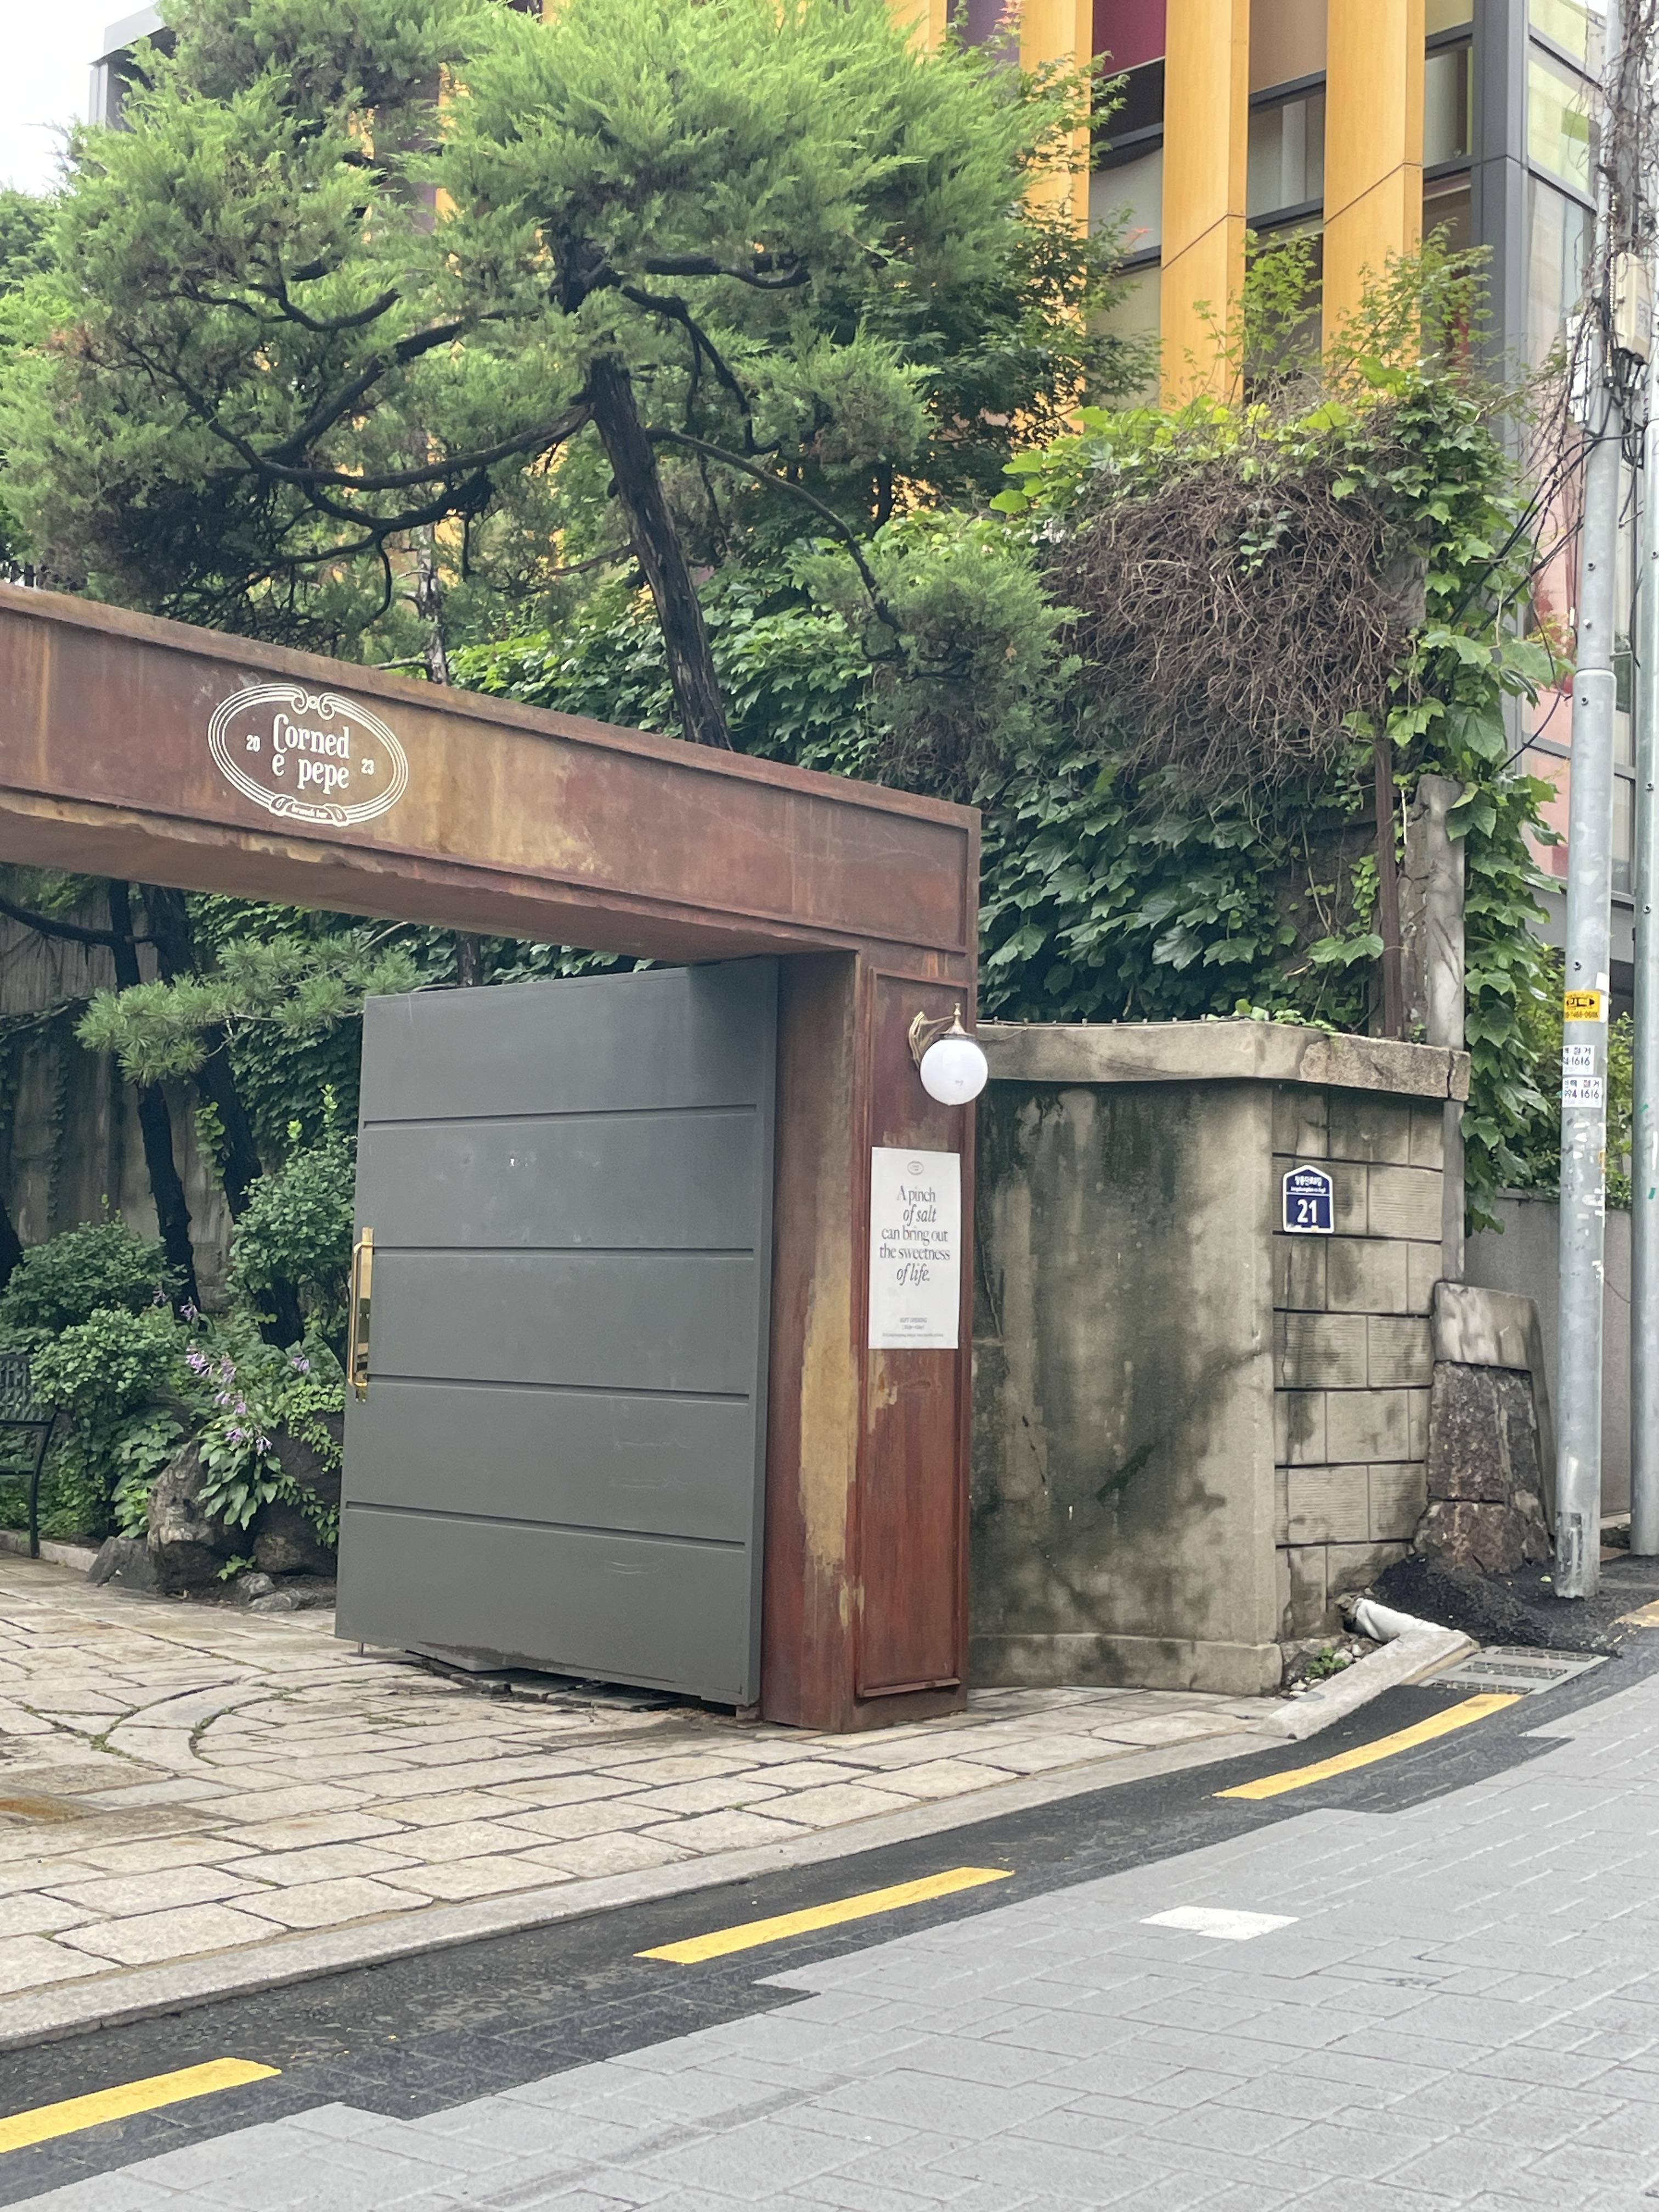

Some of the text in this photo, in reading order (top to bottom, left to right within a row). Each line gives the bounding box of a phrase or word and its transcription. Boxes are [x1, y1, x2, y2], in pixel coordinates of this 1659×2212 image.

[246, 734, 261, 752] 20
[273, 713, 350, 759] Corned
[297, 758, 349, 794] pepe
[361, 758, 374, 775] 23
[896, 1185, 935, 1206] A pinch
[903, 1204, 936, 1226] of salt
[1297, 1199, 1317, 1223] 21
[882, 1224, 948, 1246] can bring out
[879, 1243, 950, 1260] the sweetness
[896, 1263, 930, 1286] of life.
